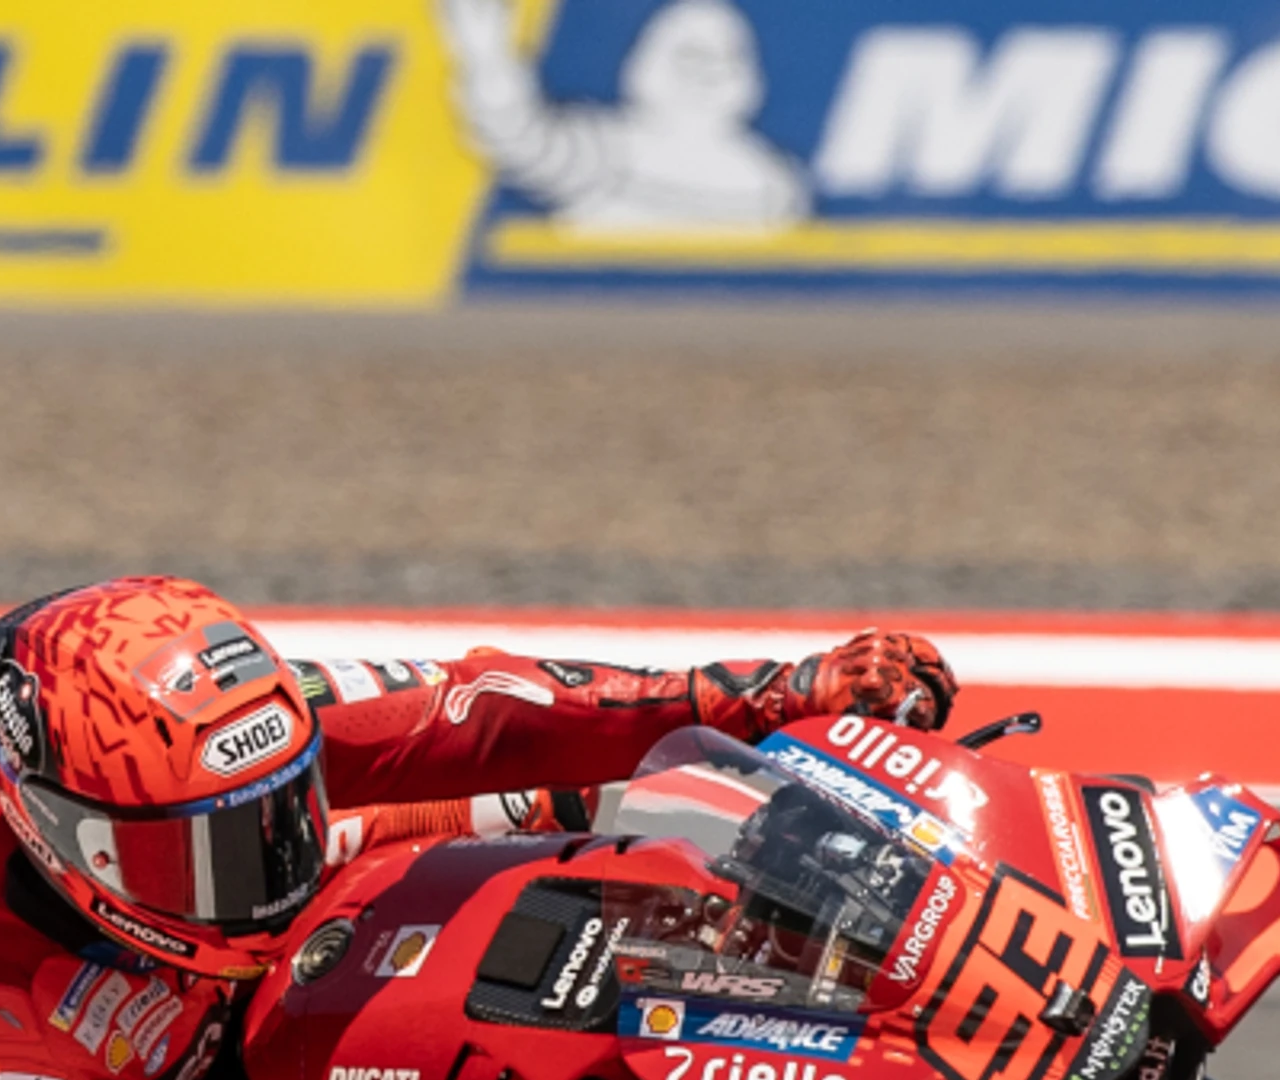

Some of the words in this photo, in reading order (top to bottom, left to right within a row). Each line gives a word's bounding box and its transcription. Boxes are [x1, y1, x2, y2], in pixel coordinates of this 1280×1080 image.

[217, 714, 287, 766] SHOEI
[1098, 791, 1167, 951] Lenovo
[98, 902, 188, 954] Lenovo
[540, 917, 603, 1009] Lenovo
[888, 874, 958, 986] VARGROUP
[681, 971, 785, 997] WRS
[696, 1013, 849, 1051] ADVANCE
[1081, 978, 1147, 1080] MONSTER
